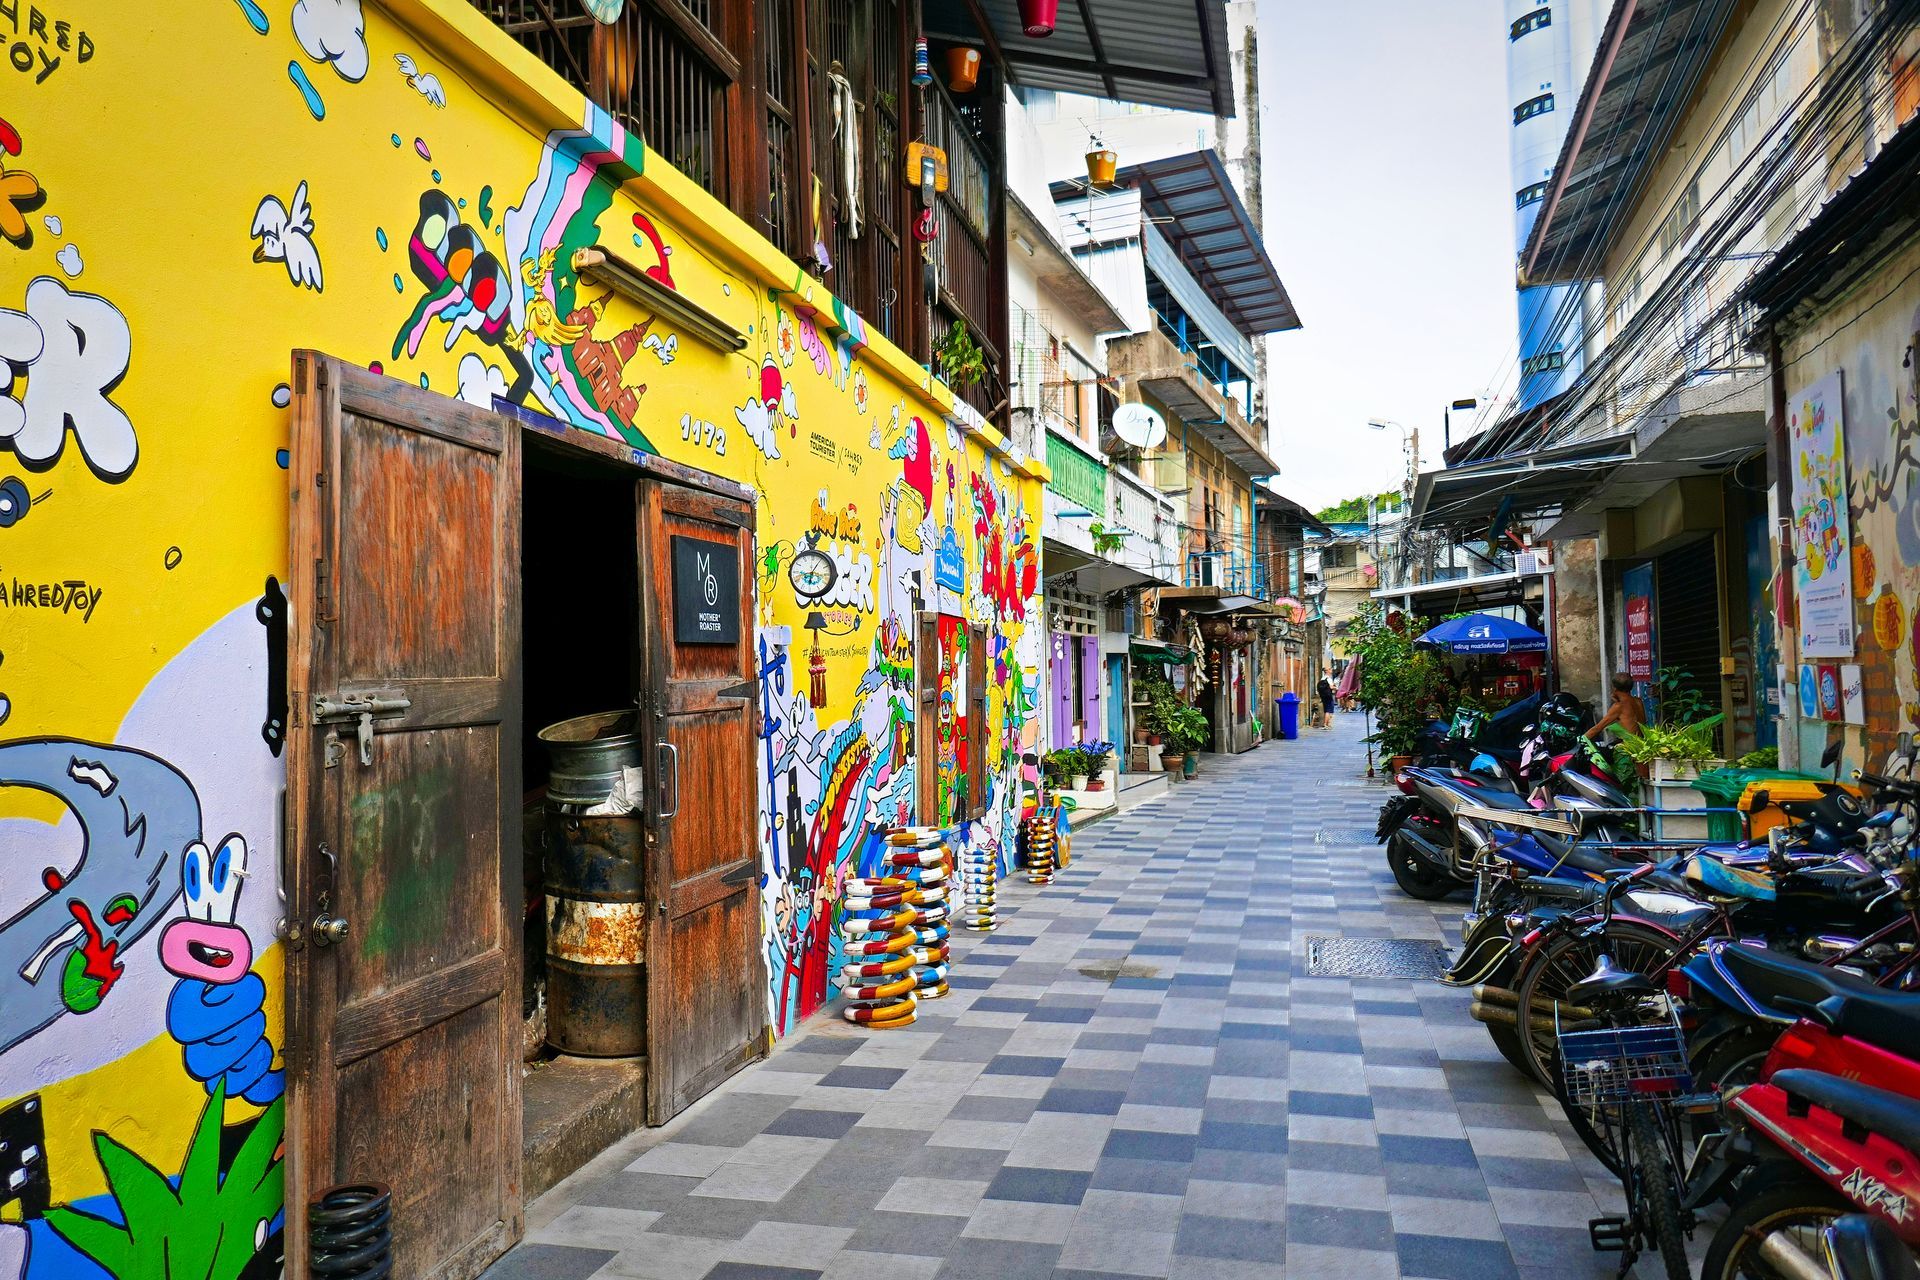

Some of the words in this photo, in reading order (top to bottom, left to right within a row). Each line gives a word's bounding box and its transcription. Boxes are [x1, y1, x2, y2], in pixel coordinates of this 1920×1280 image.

[680, 413, 727, 457] 1172
[810, 431, 836, 450] AMERICAN
[809, 440, 836, 459] TOURISTER
[699, 621, 722, 632] ROASTER
